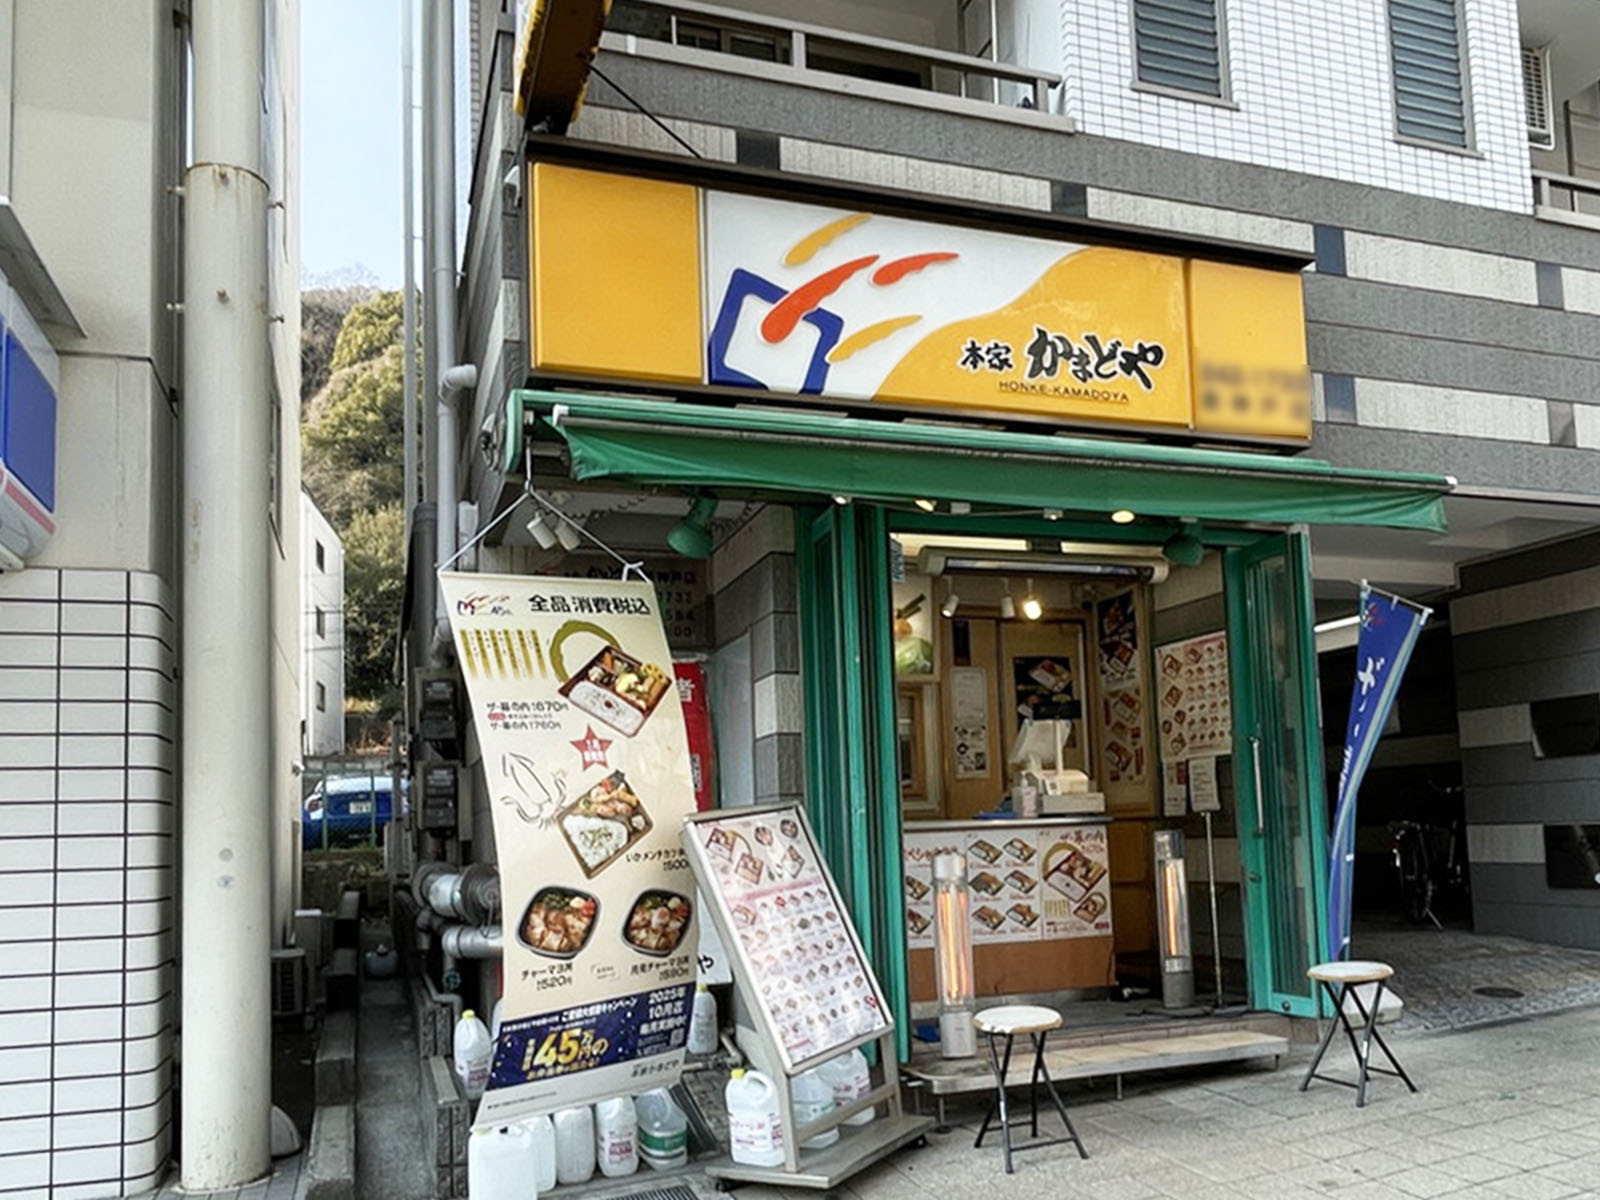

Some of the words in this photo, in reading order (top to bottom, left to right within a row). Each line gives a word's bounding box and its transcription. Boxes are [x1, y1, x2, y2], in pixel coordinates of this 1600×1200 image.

[961, 338, 1014, 372] 本家
[1026, 325, 1165, 391] かまどや
[999, 380, 1130, 404] HONKE-KAMADOYA
